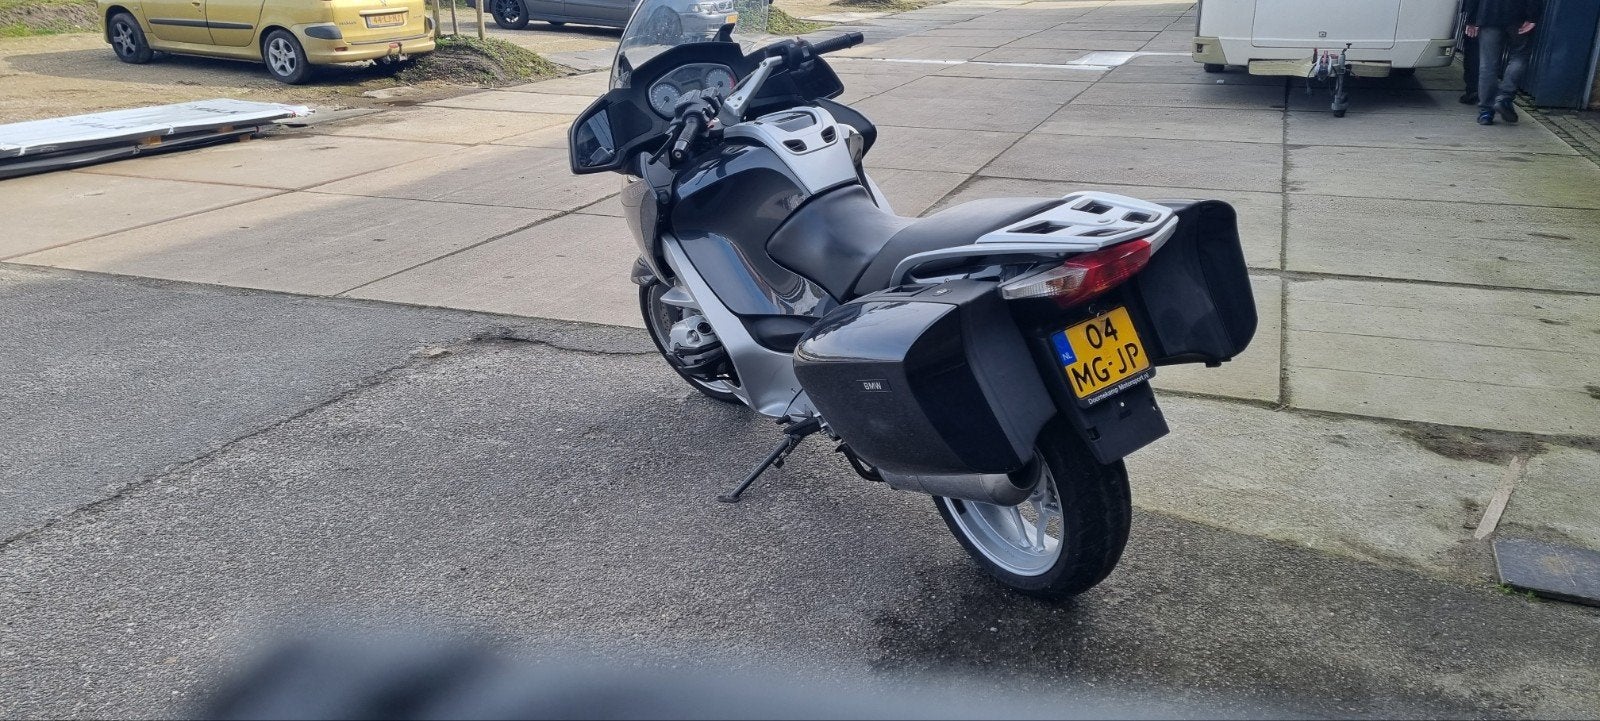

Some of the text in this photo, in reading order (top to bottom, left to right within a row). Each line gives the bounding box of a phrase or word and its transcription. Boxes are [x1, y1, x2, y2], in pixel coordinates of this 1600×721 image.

[1085, 317, 1118, 349] 04
[1062, 351, 1073, 361] NL
[1071, 342, 1139, 393] MG-JP
[863, 382, 882, 390] BMW
[1118, 372, 1150, 391] Motorsport.nl
